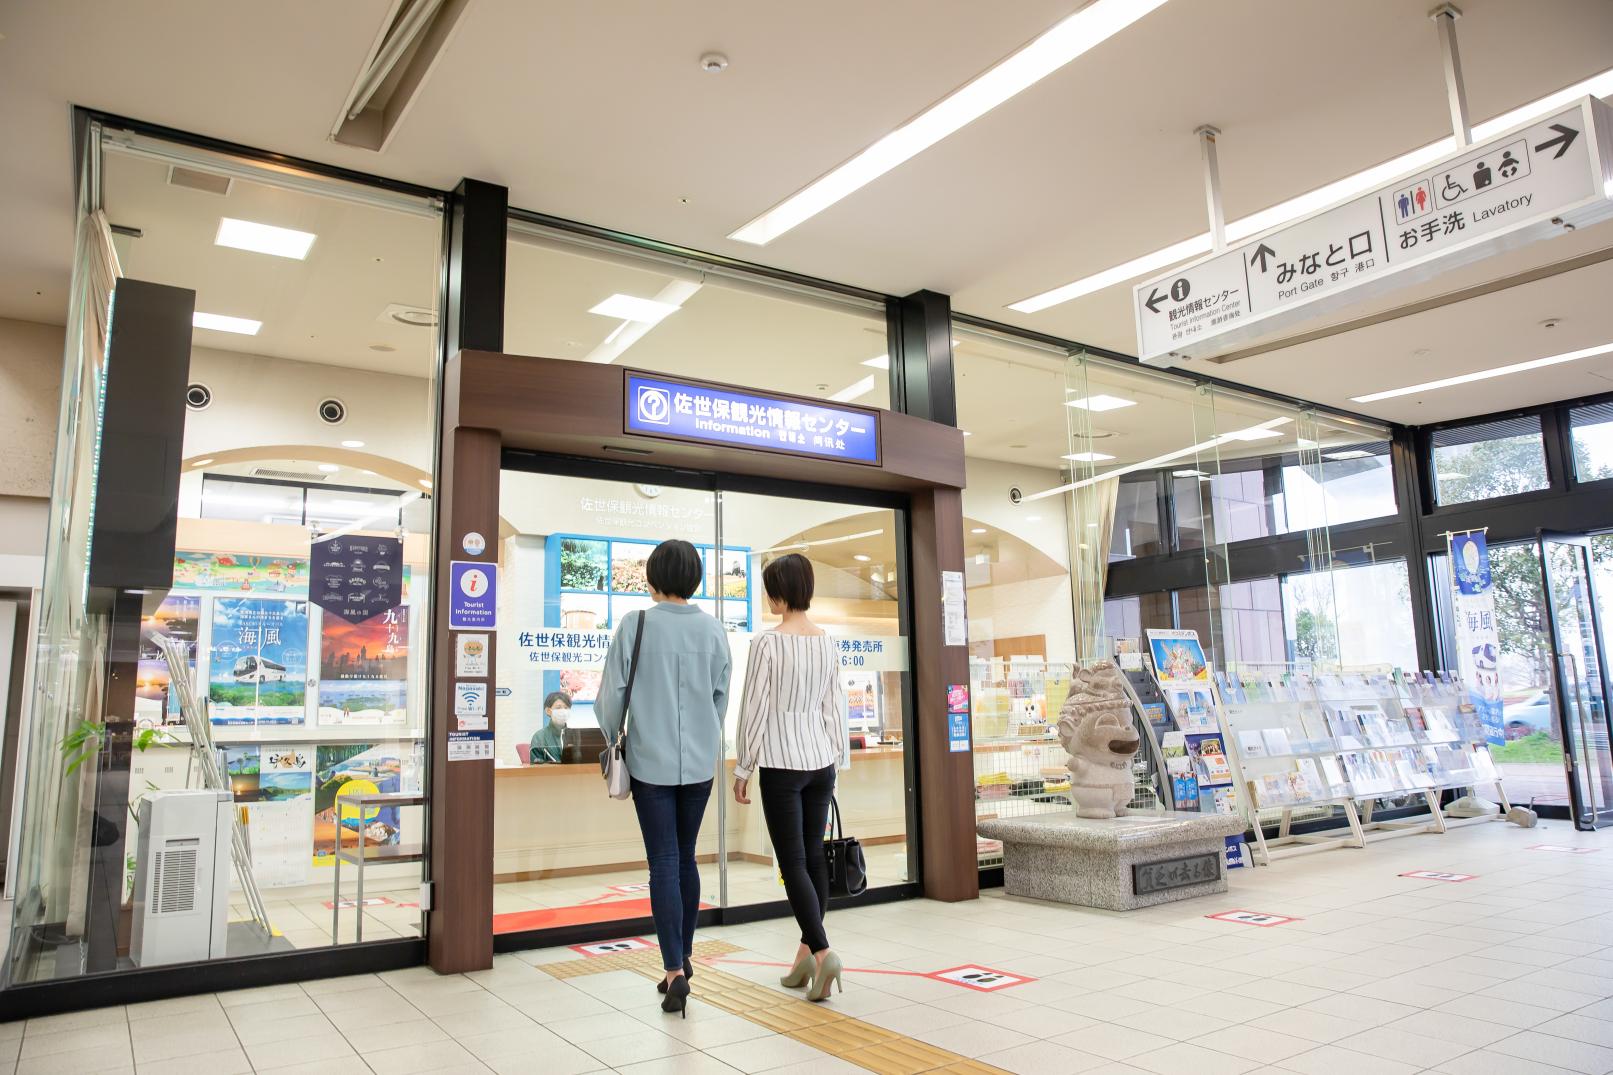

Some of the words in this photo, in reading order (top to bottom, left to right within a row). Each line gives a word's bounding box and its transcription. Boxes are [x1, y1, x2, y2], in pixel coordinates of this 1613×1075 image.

[1472, 193, 1533, 223] Lavatory
[1399, 210, 1466, 250] お手洗
[1276, 230, 1373, 285] みなと口
[1354, 258, 1375, 273] 港口
[1278, 287, 1298, 300] Port
[1300, 278, 1324, 292] Gate
[1168, 289, 1239, 322] 観光情報センター
[1170, 319, 1189, 331] Tourist
[1189, 308, 1220, 324] Information
[1221, 300, 1240, 313] Center
[673, 392, 867, 436] 佐世保観光情報センター
[695, 417, 770, 440] Information
[455, 608, 492, 616] Information
[239, 626, 282, 650] 海風
[518, 631, 610, 649] 佐世保観光情
[529, 651, 607, 663] 佐世保観光コン
